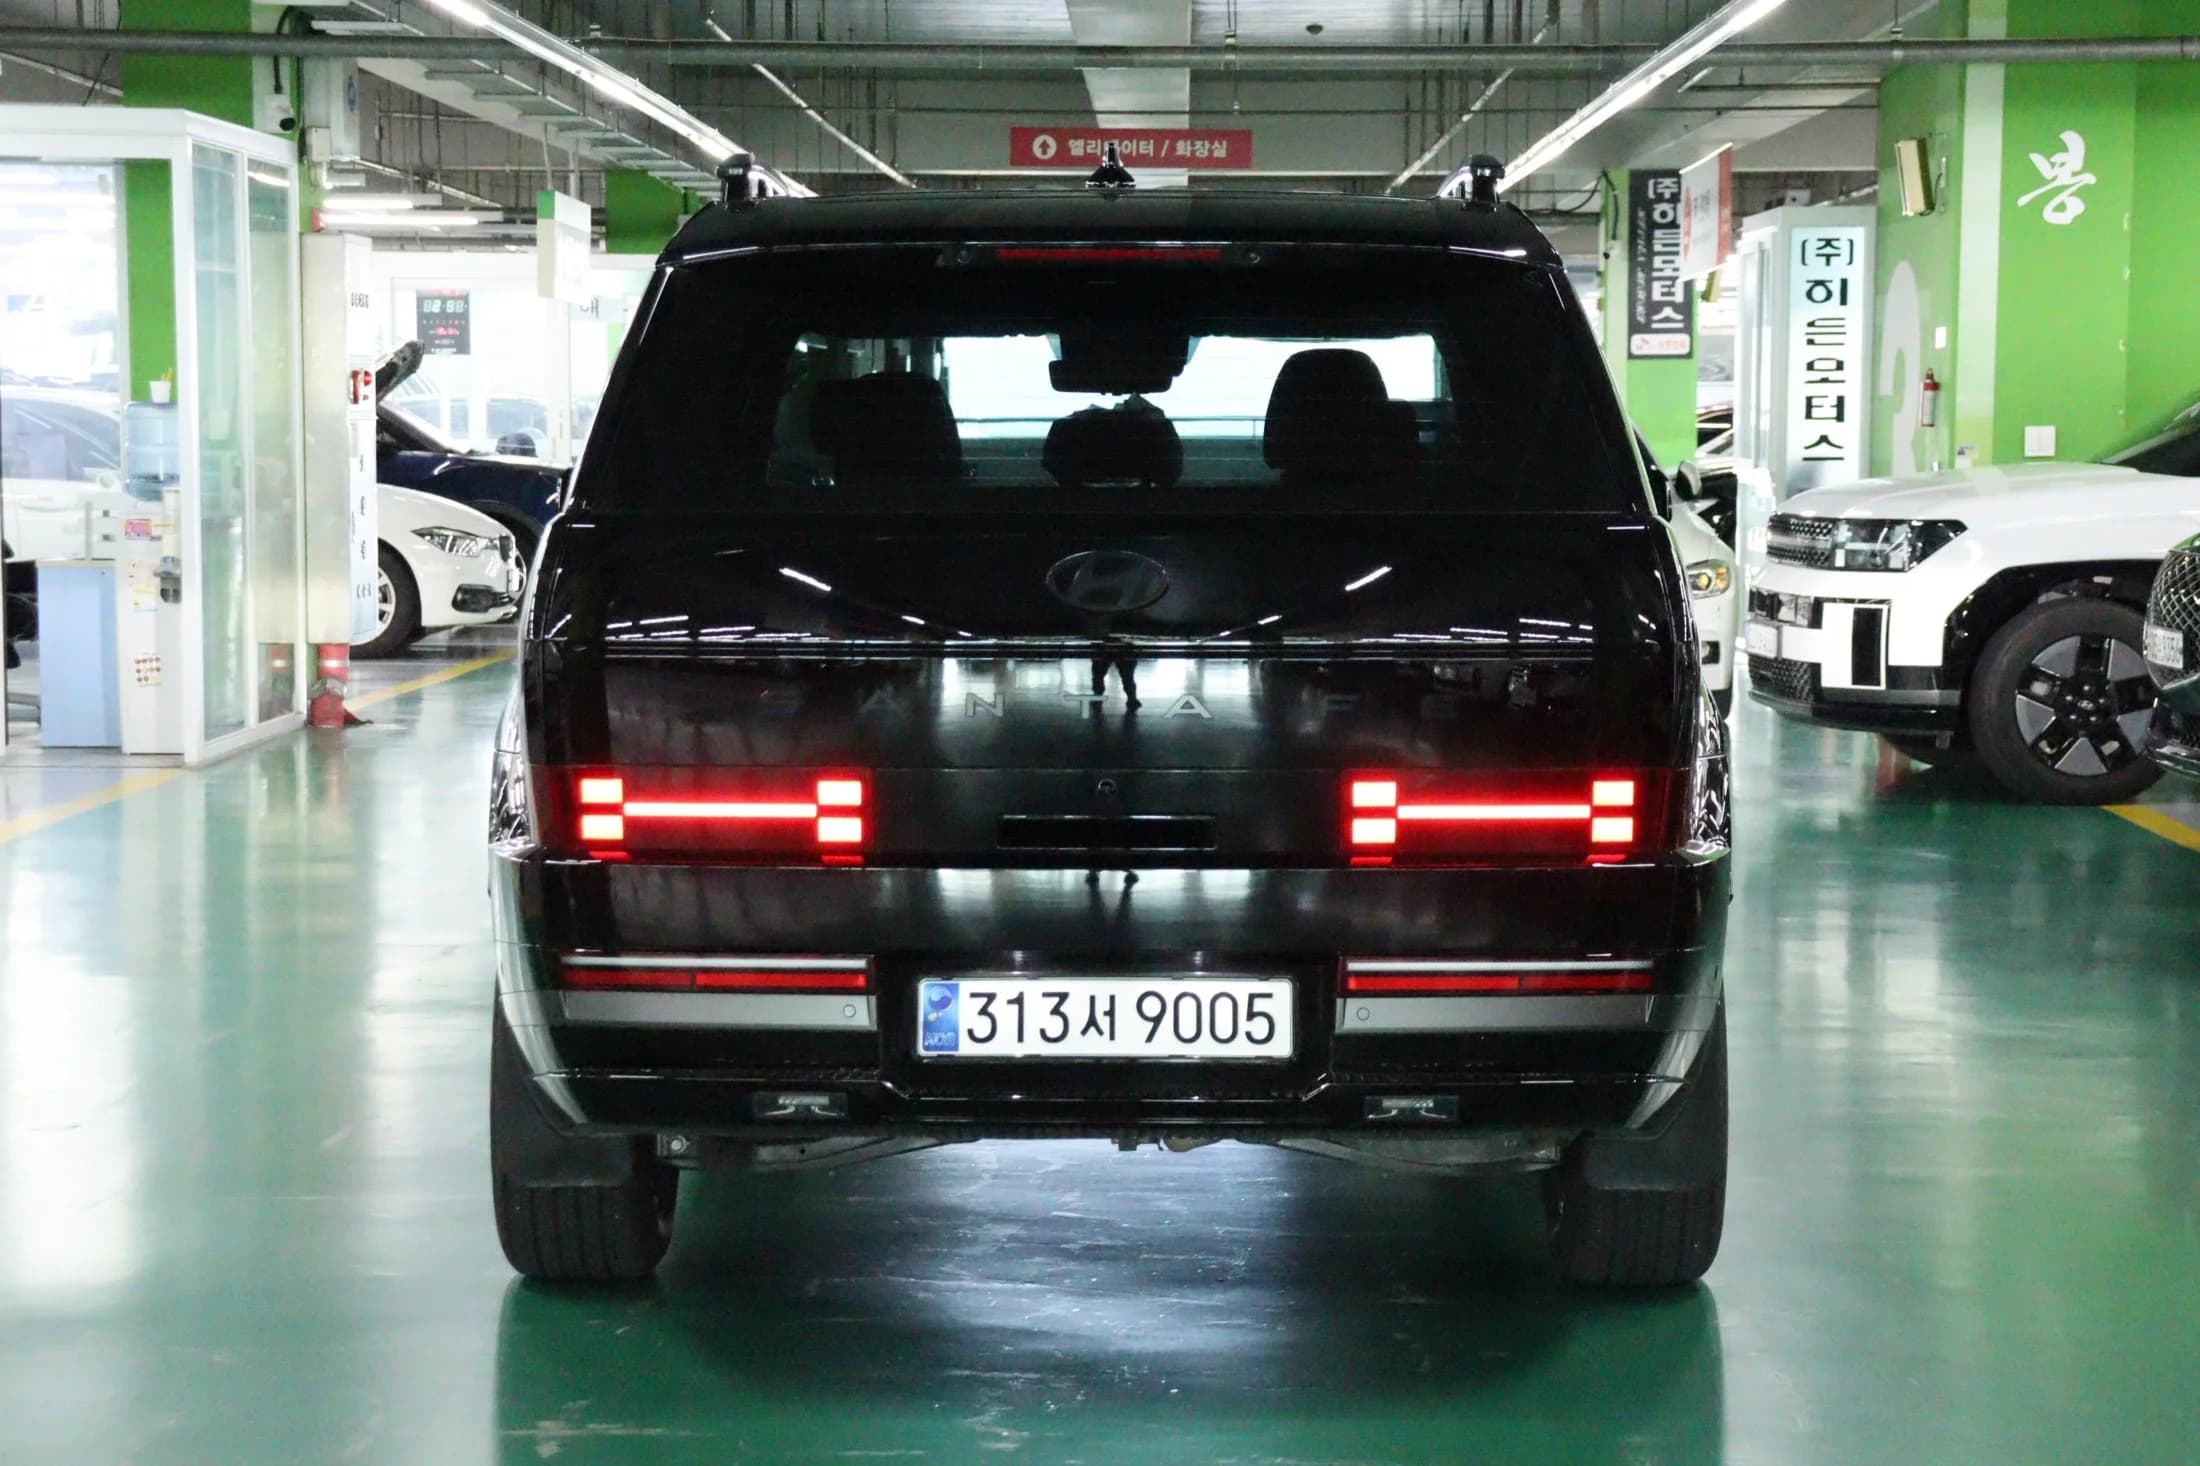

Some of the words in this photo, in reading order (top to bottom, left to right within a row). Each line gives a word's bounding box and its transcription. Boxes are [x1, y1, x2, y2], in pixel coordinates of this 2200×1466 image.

[1176, 139, 1227, 157] 화장실
[967, 991, 1116, 1044] 313서
[1136, 990, 1275, 1045] 9005
